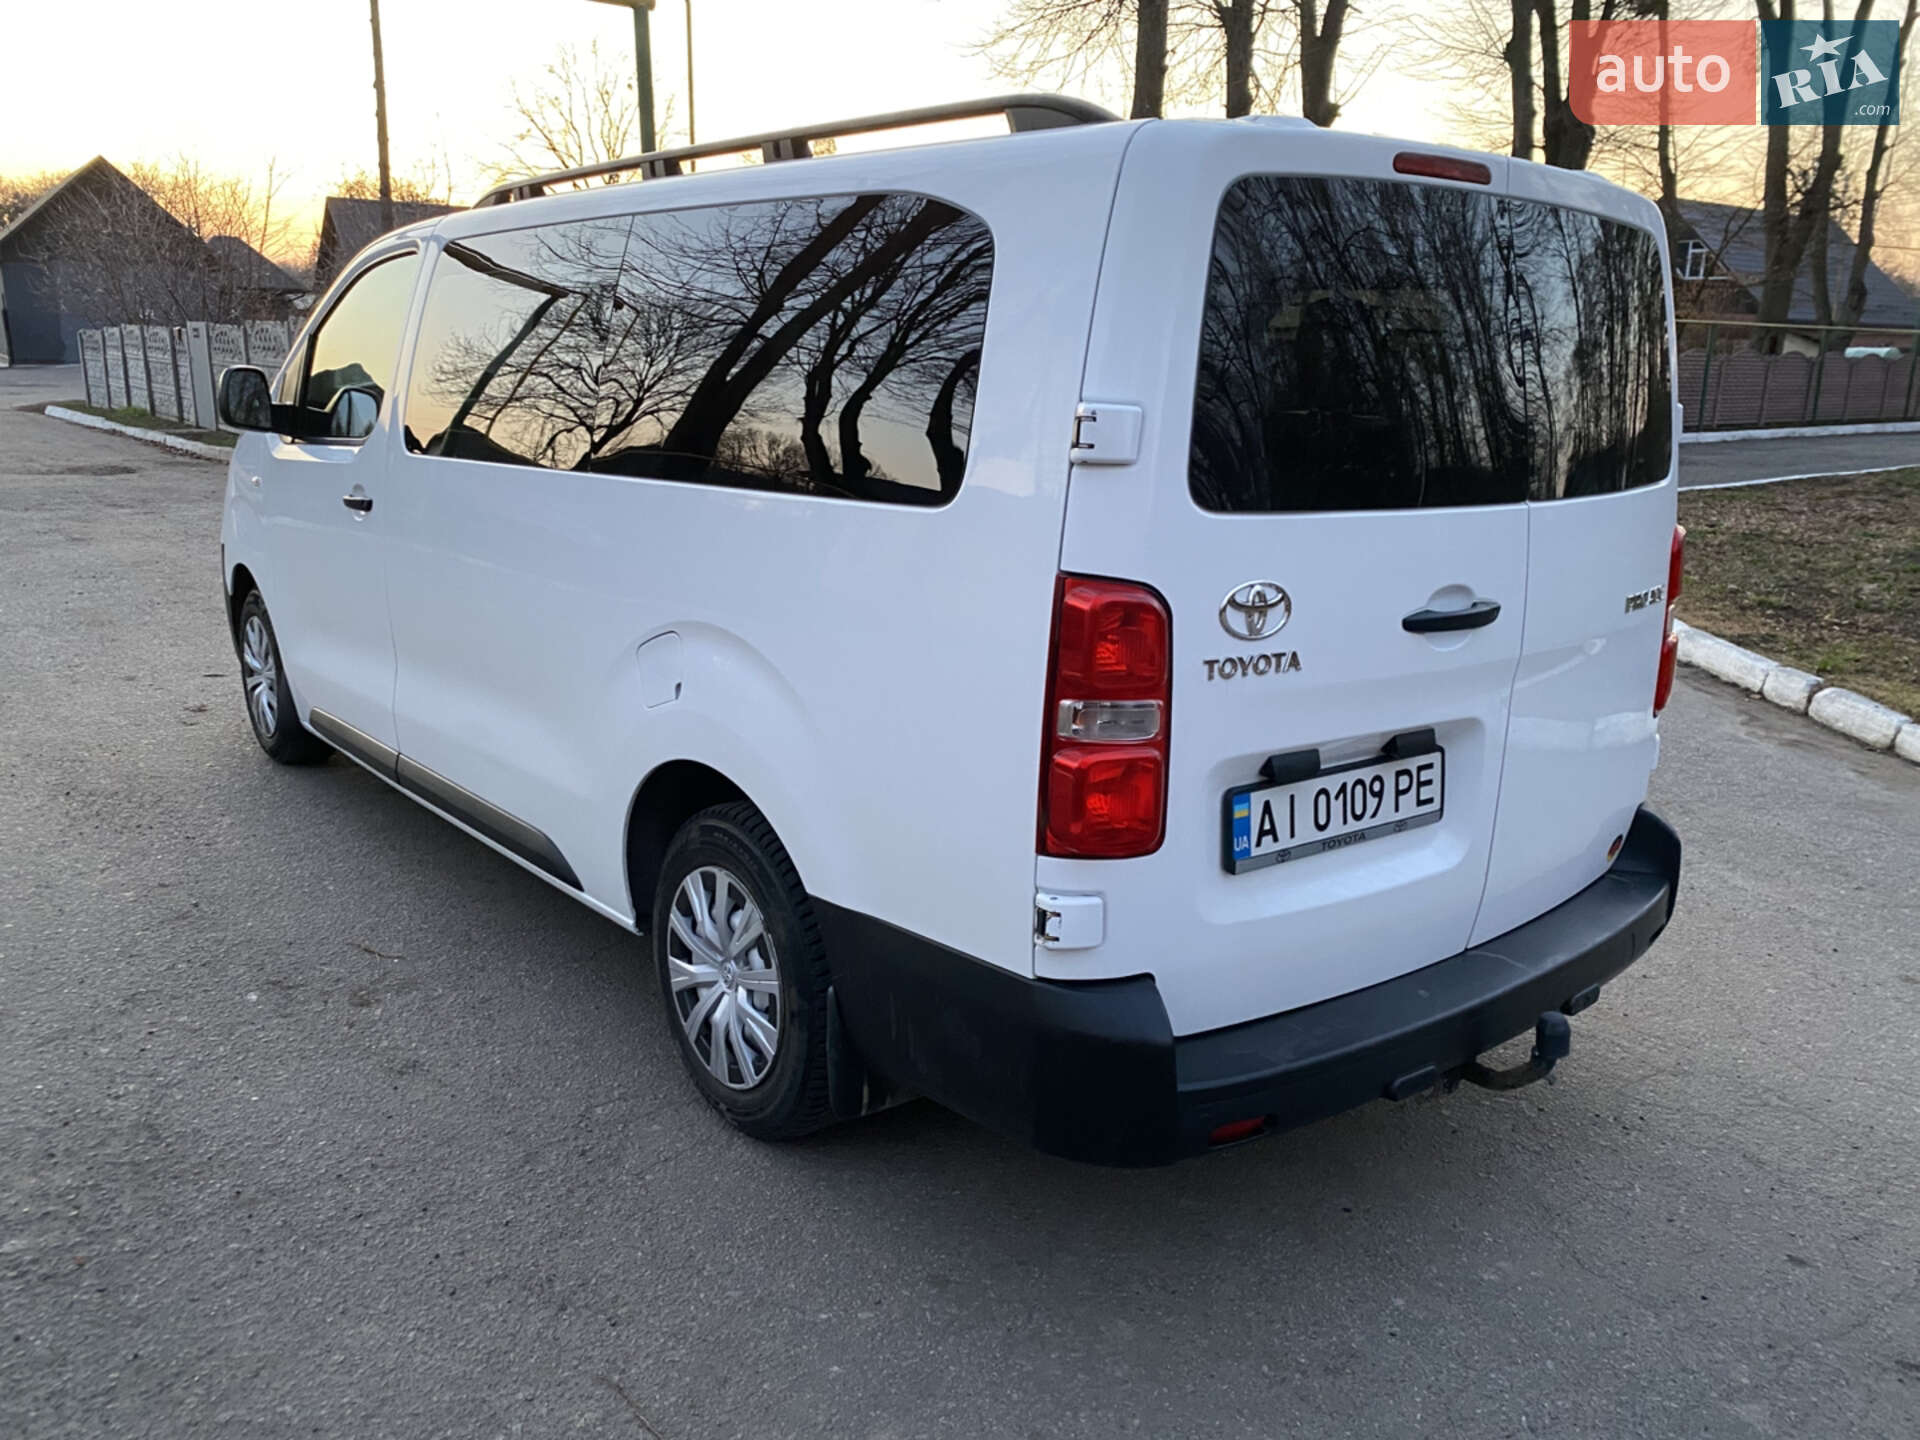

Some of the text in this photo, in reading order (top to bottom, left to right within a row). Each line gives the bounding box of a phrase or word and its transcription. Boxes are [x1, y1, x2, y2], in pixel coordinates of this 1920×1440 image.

[1203, 650, 1302, 681] TOYOTA
[1255, 762, 1435, 848] AI 0109 PE
[1233, 836, 1250, 852] UA
[1321, 831, 1367, 851] TOYOTA
